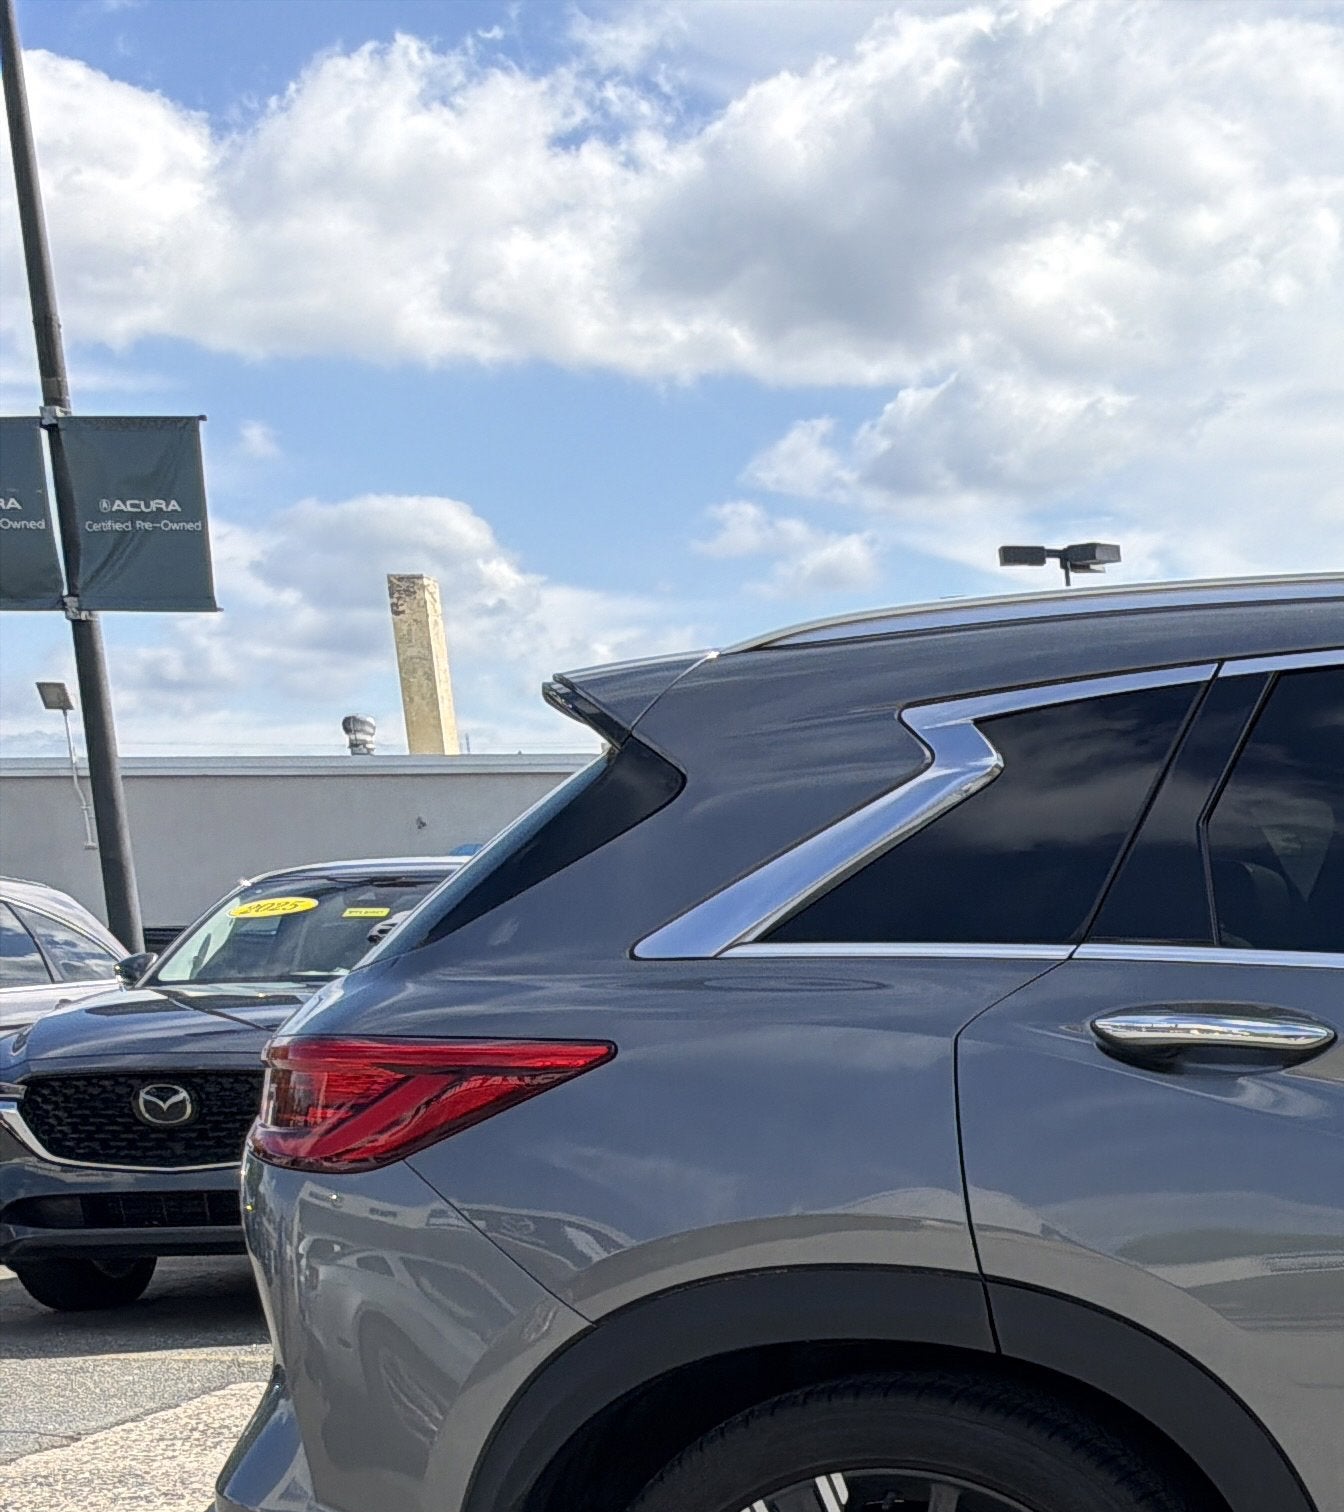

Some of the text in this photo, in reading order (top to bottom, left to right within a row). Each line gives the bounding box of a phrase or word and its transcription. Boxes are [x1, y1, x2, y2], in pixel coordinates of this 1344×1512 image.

[111, 499, 182, 512] ACURA
[85, 519, 202, 532] Certified Pre-Owned
[239, 901, 302, 914] 2025
